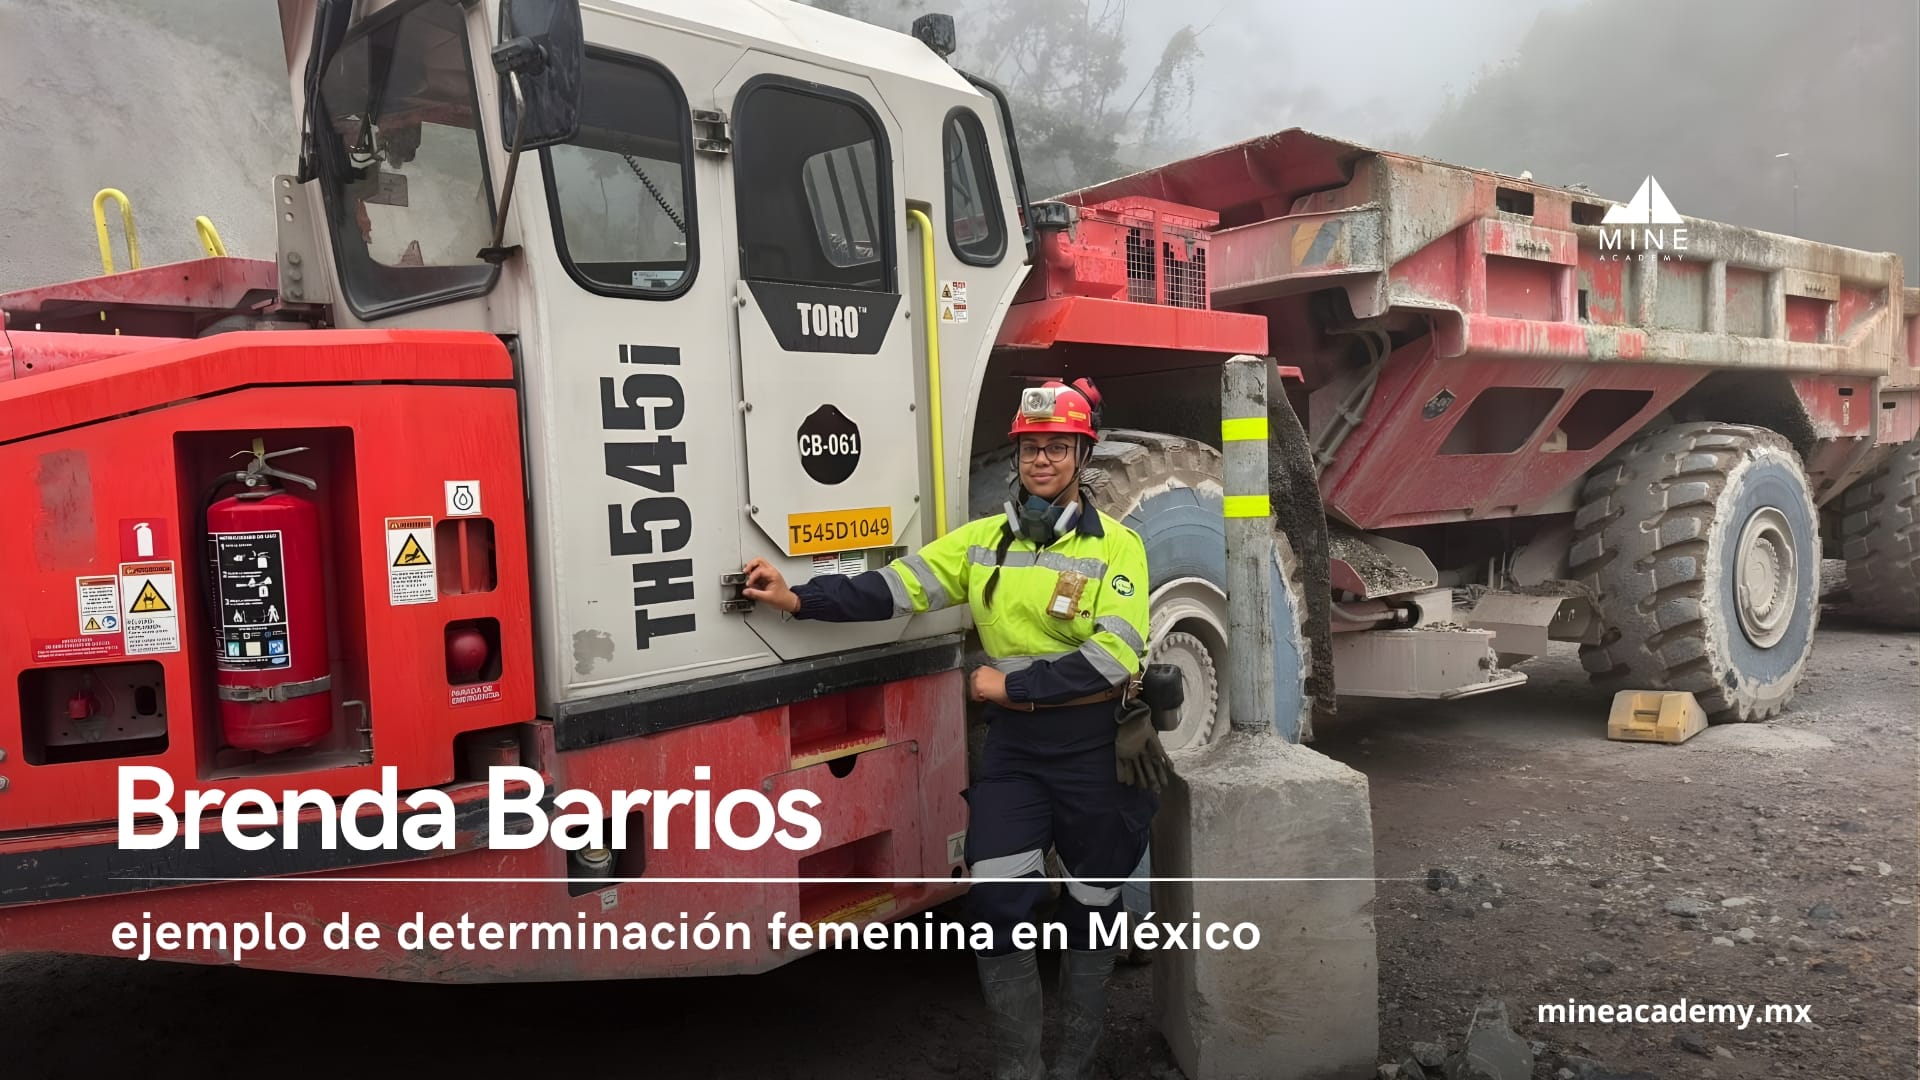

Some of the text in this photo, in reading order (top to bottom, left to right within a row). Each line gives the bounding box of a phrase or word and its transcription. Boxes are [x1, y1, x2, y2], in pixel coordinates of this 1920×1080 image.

[796, 302, 859, 338] TORO
[799, 433, 859, 456] CB-061
[599, 344, 697, 650] TH545i
[789, 518, 890, 544] T545D1049
